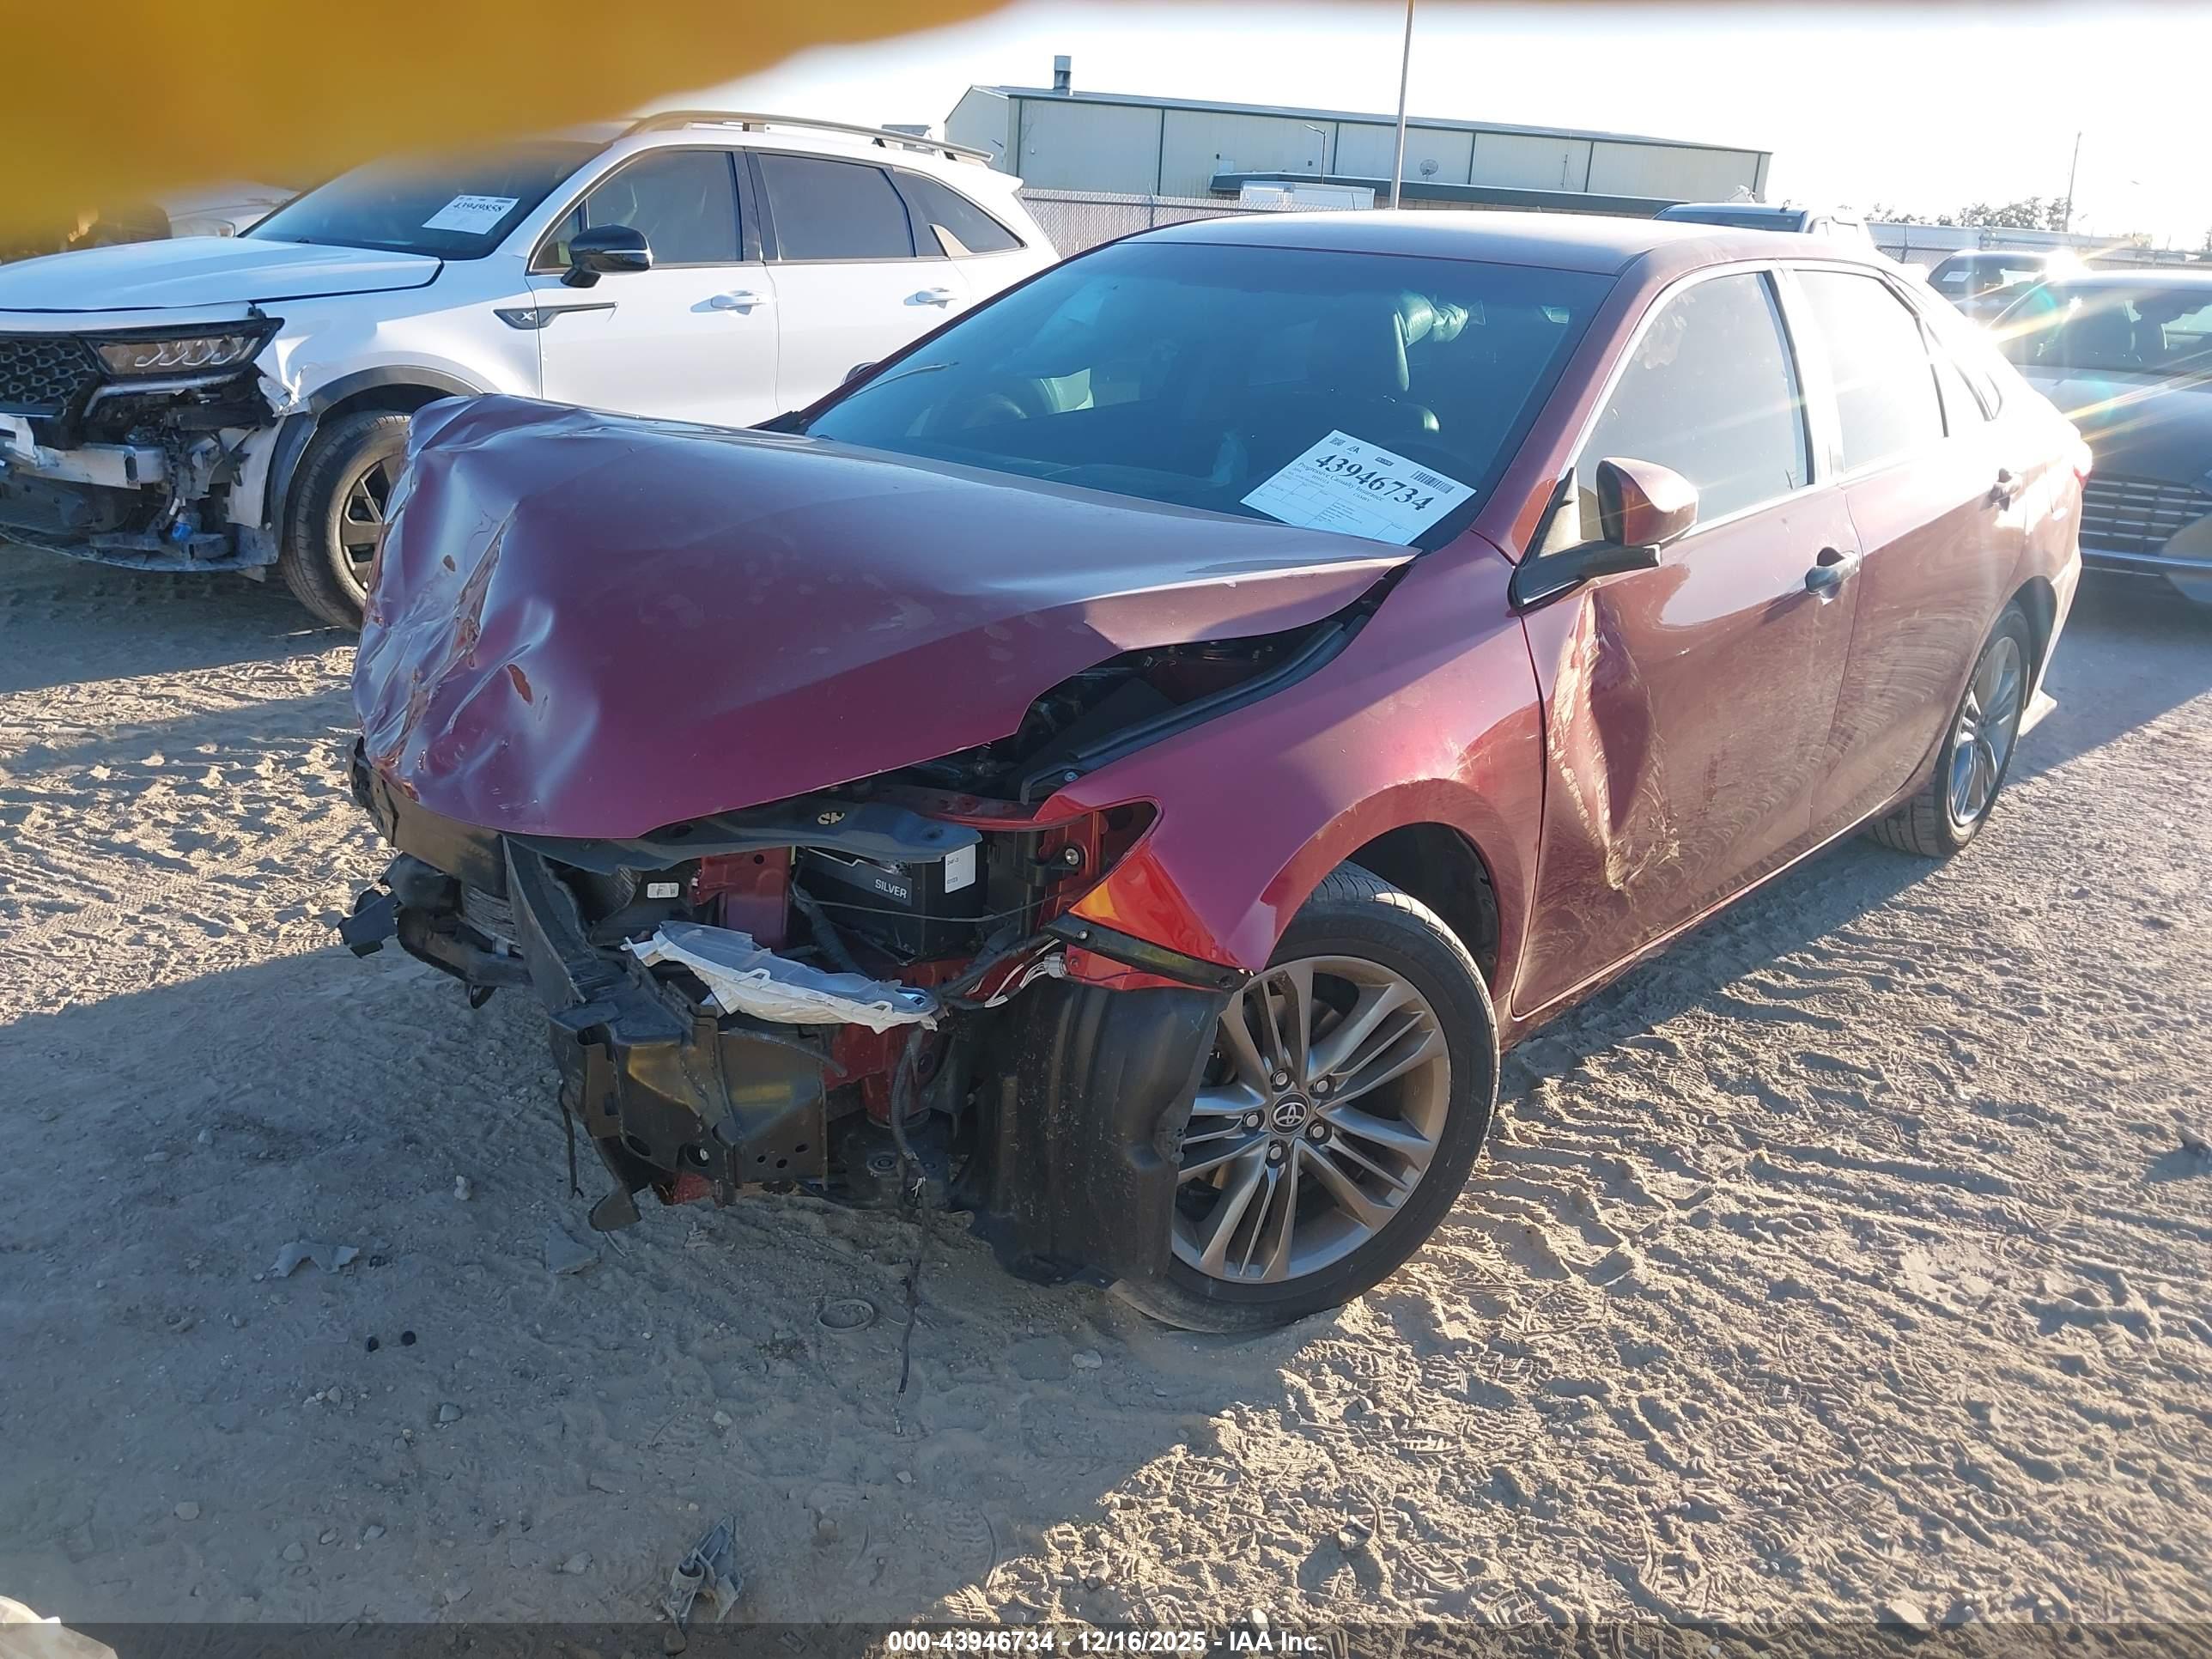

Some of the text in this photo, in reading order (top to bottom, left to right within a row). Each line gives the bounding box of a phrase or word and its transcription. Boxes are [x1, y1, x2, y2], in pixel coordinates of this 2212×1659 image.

[1297, 462, 1331, 478] Progressive
[1330, 474, 1355, 489] Casualty
[1356, 485, 1386, 501] Insurance
[1316, 454, 1436, 511] 43946734
[875, 878, 908, 899] SILVER
